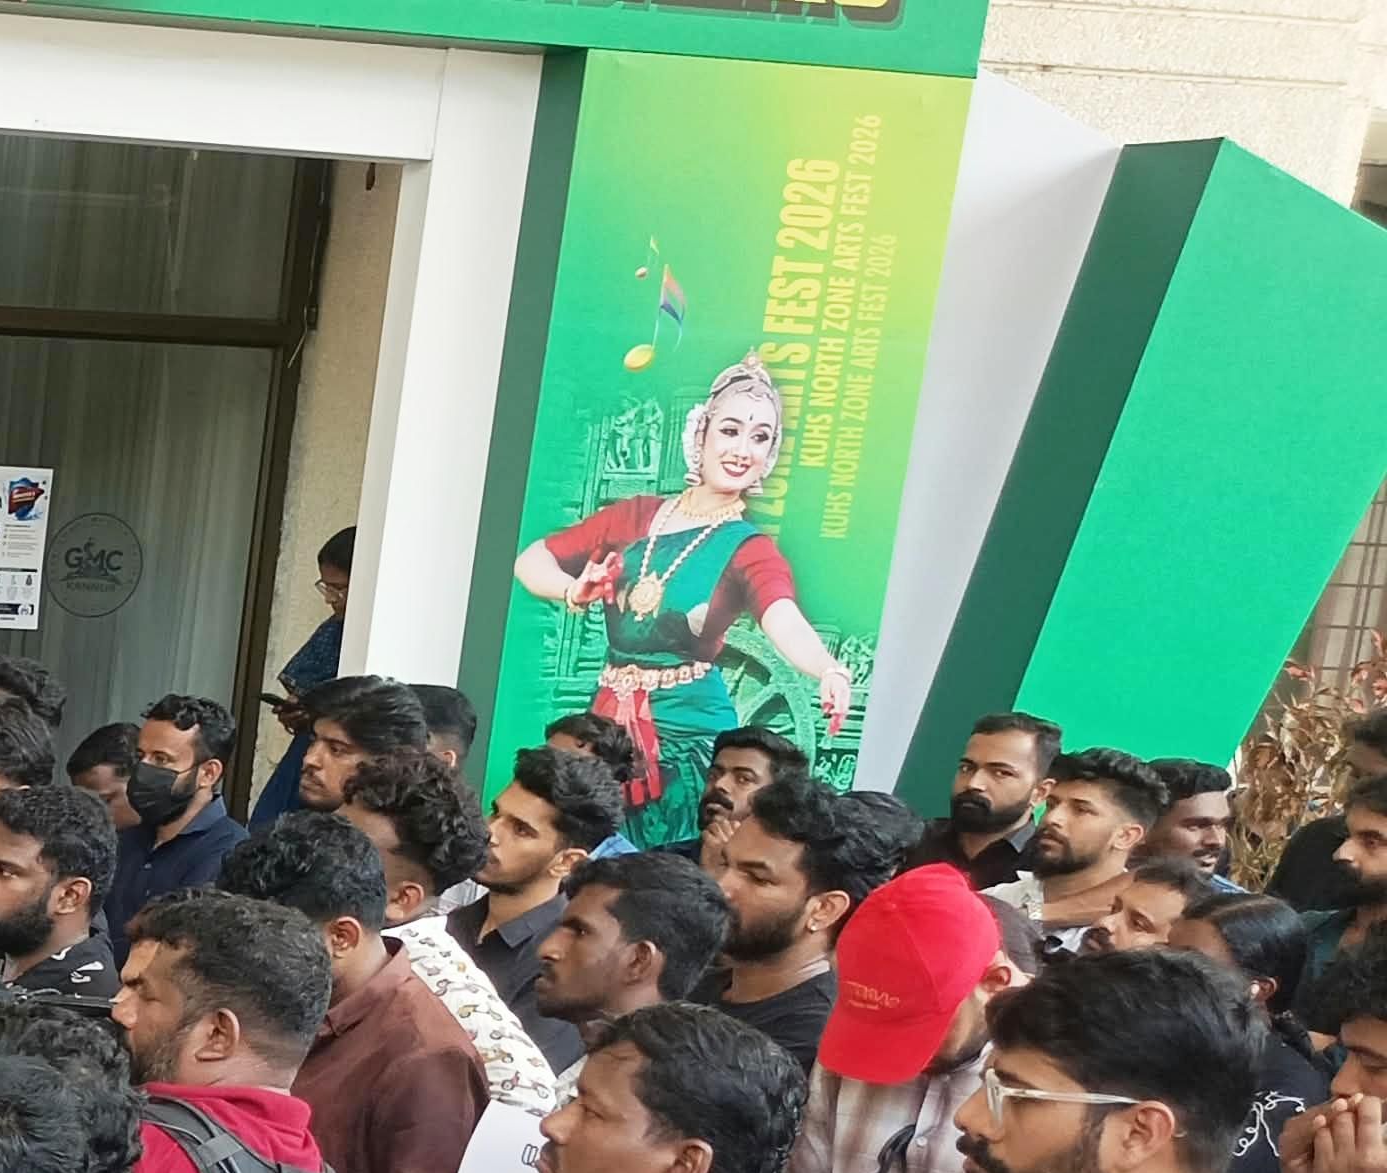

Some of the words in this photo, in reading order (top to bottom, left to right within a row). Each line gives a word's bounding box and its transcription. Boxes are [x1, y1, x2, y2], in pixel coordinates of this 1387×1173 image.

[847, 115, 882, 166] 2026
[776, 158, 840, 251] 2026
[840, 171, 873, 216] FEST
[832, 222, 865, 272] ARTS
[865, 234, 898, 278] 2026
[762, 255, 824, 335] FEST
[822, 276, 857, 332] ZONE
[857, 283, 889, 321] FEST
[809, 337, 846, 407] NORTH
[851, 327, 881, 370] ARTS
[840, 374, 874, 422] ZONE
[799, 414, 833, 467] KUHS
[829, 427, 864, 487] NORTH
[819, 492, 853, 539] KUHS
[65, 546, 124, 573] GMC
